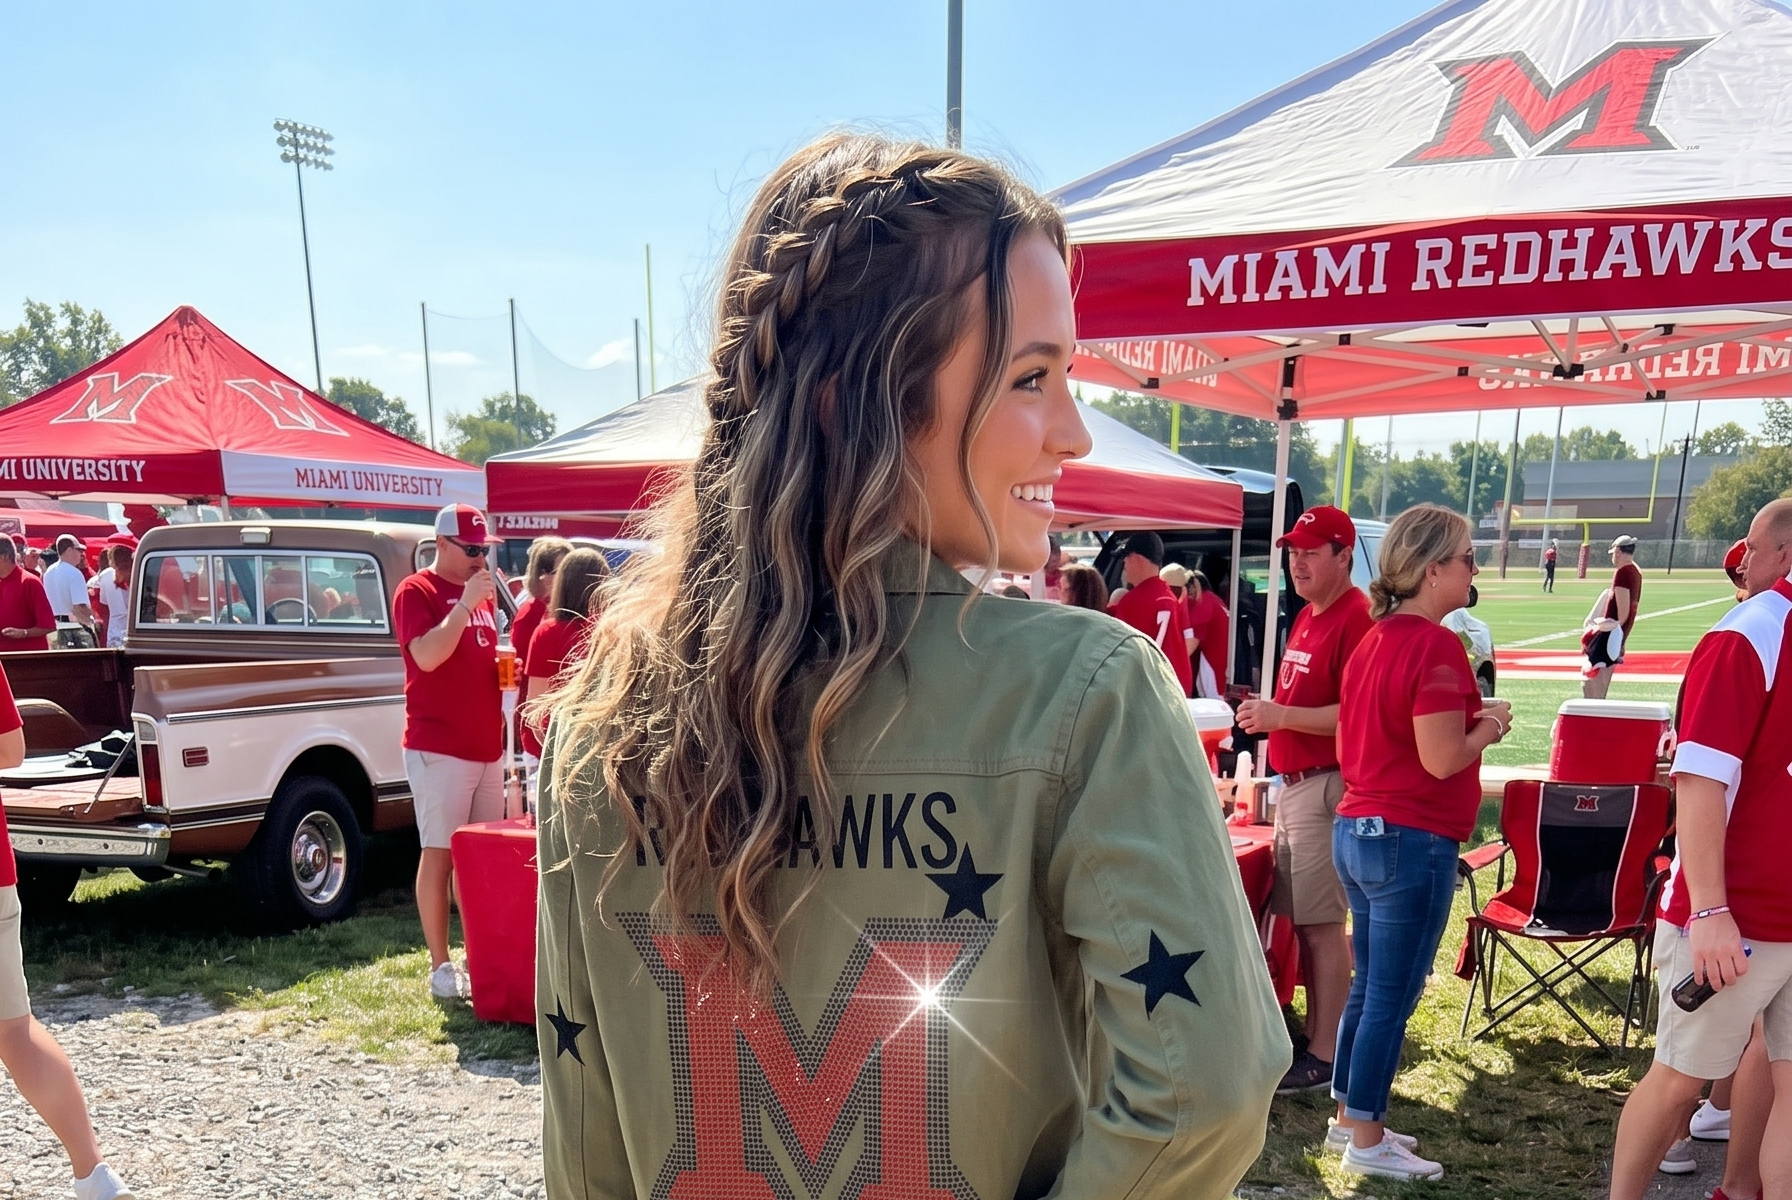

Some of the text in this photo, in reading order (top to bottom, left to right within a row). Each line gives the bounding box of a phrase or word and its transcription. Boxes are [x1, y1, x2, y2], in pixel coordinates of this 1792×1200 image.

[1384, 31, 1729, 169] M
[1186, 217, 1792, 306] MIAMI REDHAWKS
[49, 371, 174, 425] M
[21, 458, 146, 482] UNIVERSITY
[295, 467, 443, 497] MIAMI UNIVERSITY
[1155, 610, 1171, 650] 7
[635, 791, 957, 870] RAWKS
